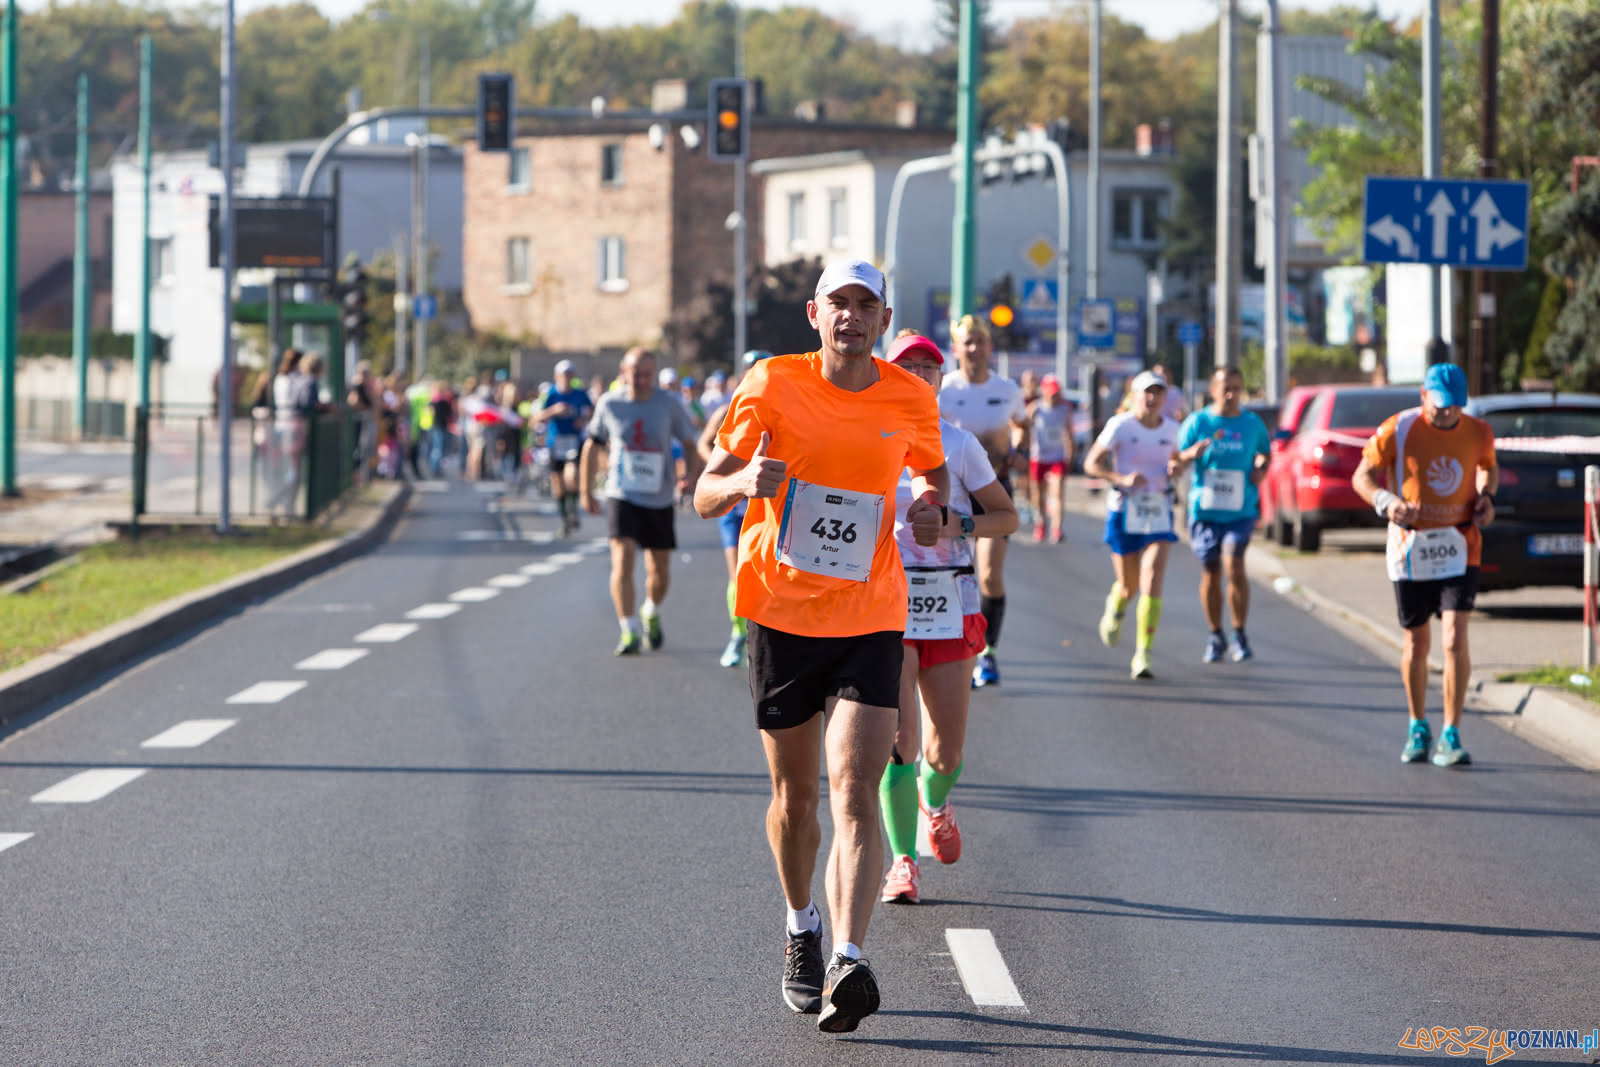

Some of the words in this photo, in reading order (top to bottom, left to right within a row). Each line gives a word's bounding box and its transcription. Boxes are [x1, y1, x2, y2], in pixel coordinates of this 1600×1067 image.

[810, 517, 857, 544] 436
[821, 544, 840, 553] Artur
[1419, 545, 1458, 560] 3506
